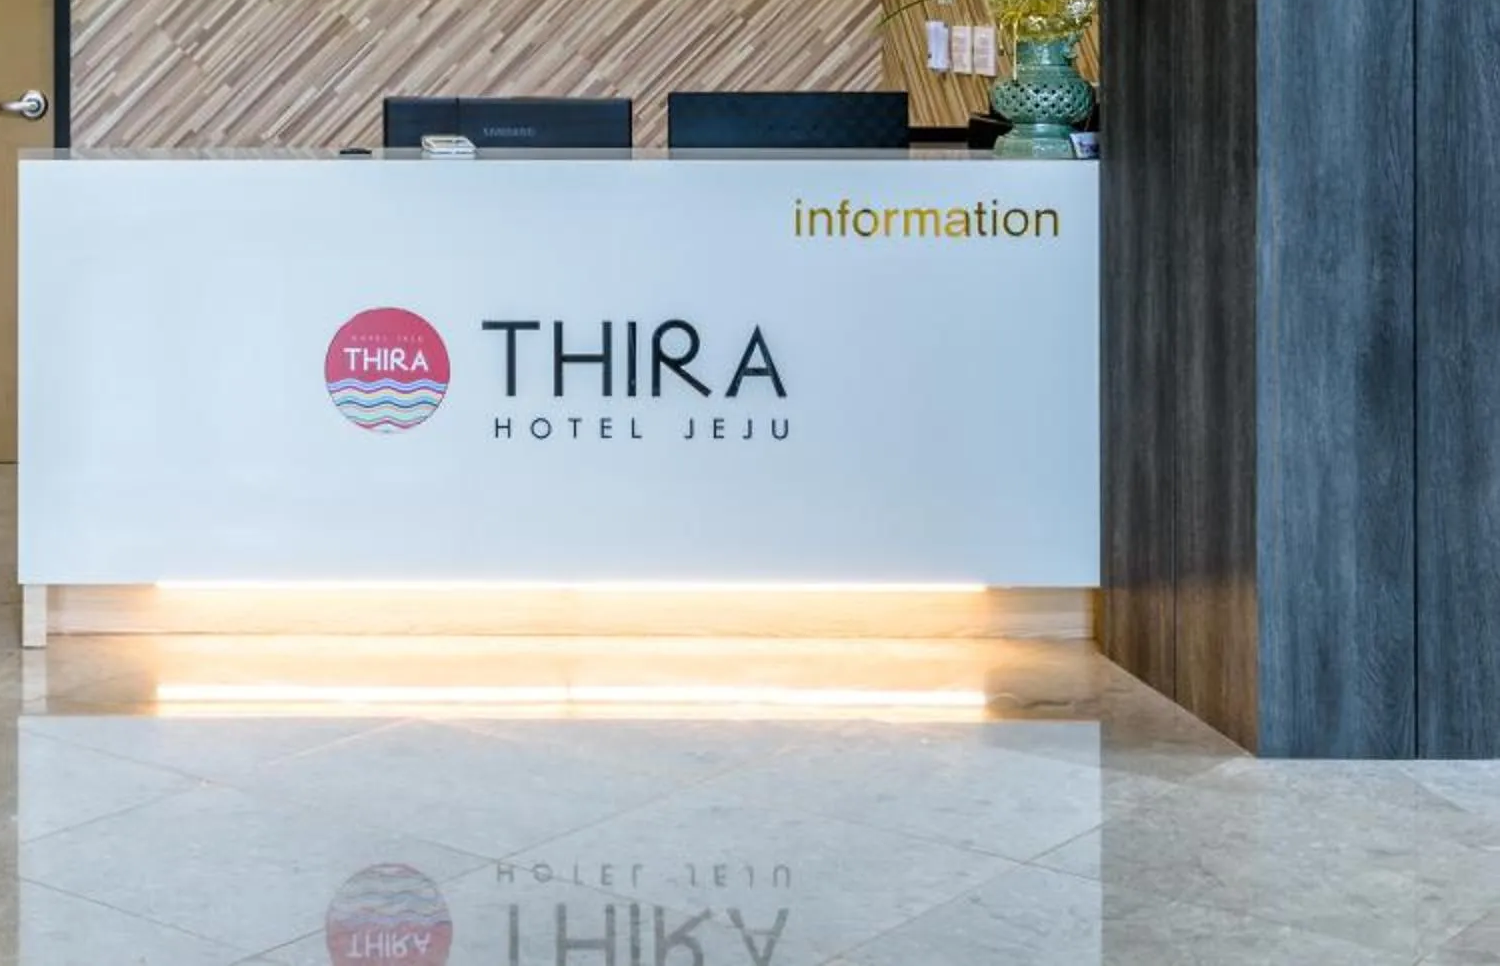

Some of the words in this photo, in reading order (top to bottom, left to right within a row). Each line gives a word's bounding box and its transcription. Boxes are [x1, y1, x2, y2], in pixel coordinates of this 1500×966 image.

[794, 199, 1060, 237] information
[342, 347, 429, 372] THIRA
[482, 320, 788, 398] THIRA
[495, 418, 642, 440] HOTEL
[684, 418, 789, 440] JEJU
